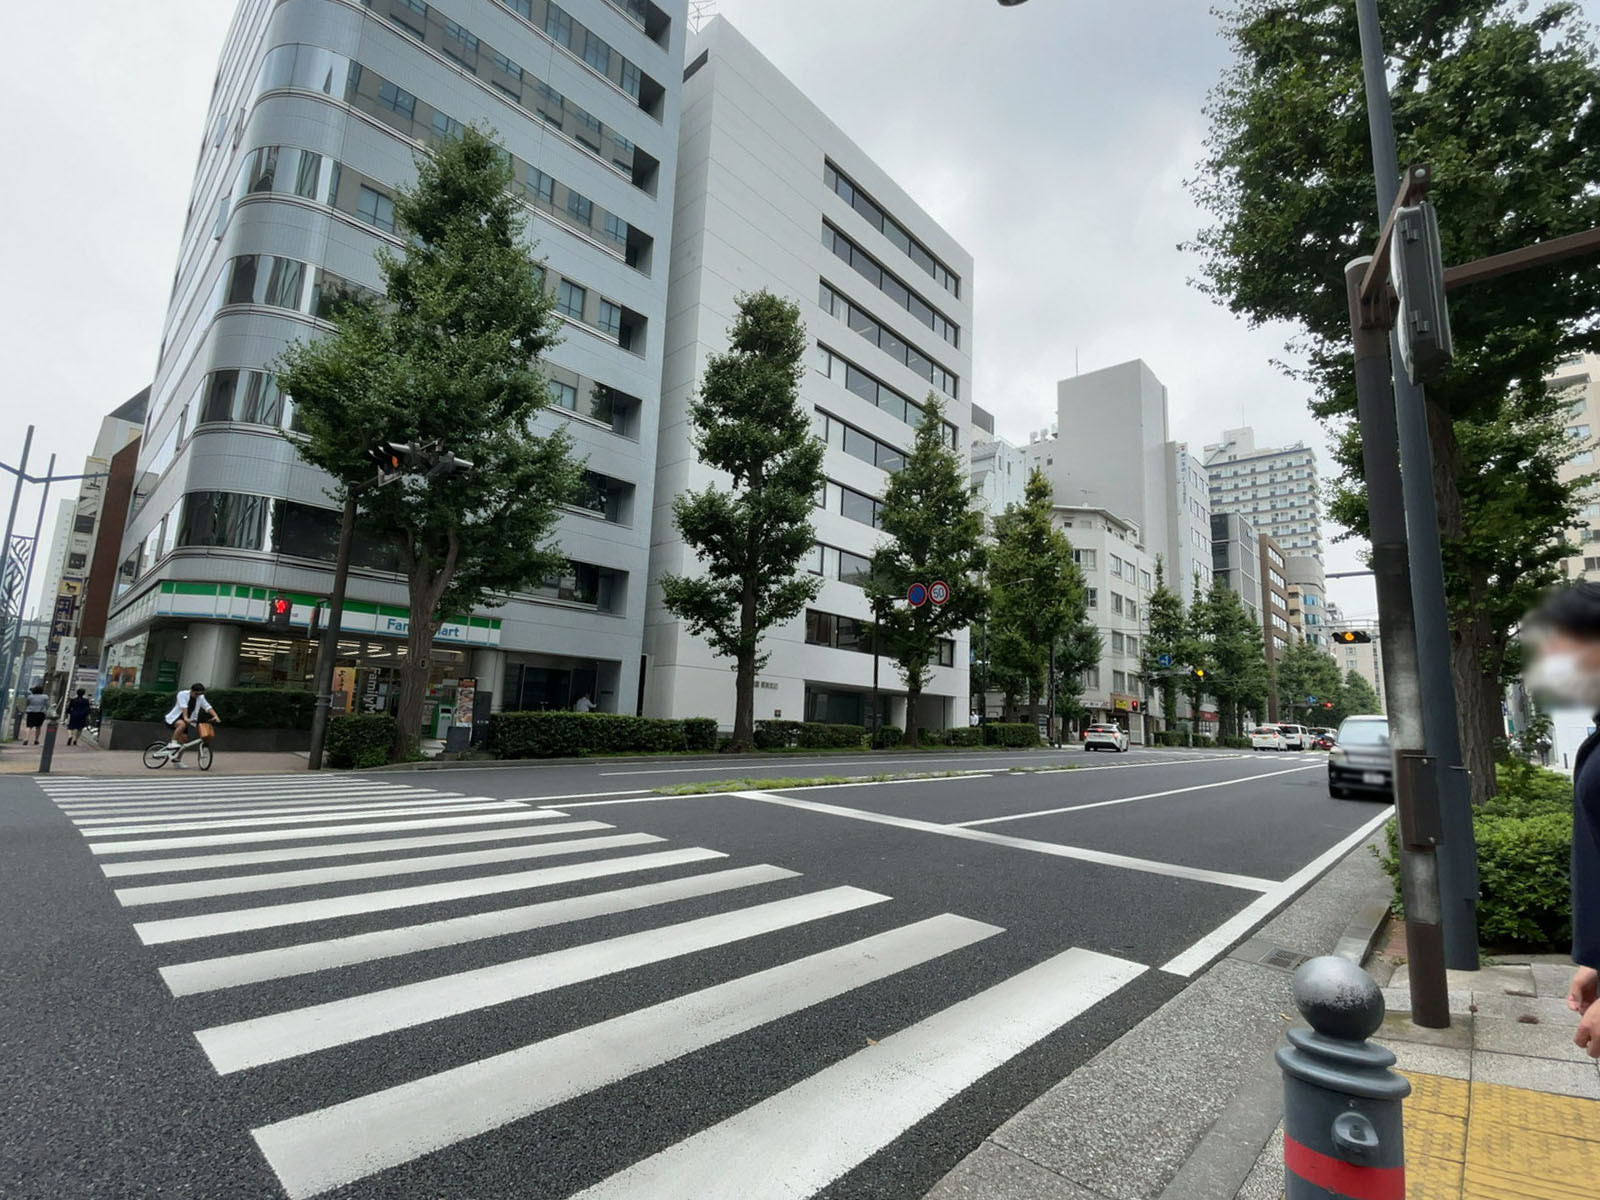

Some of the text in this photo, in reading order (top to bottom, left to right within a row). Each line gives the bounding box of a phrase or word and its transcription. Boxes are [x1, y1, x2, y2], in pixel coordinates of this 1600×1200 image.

[932, 587, 945, 599] 50
[387, 618, 460, 637] Faart
[364, 667, 381, 714] FamilyM
